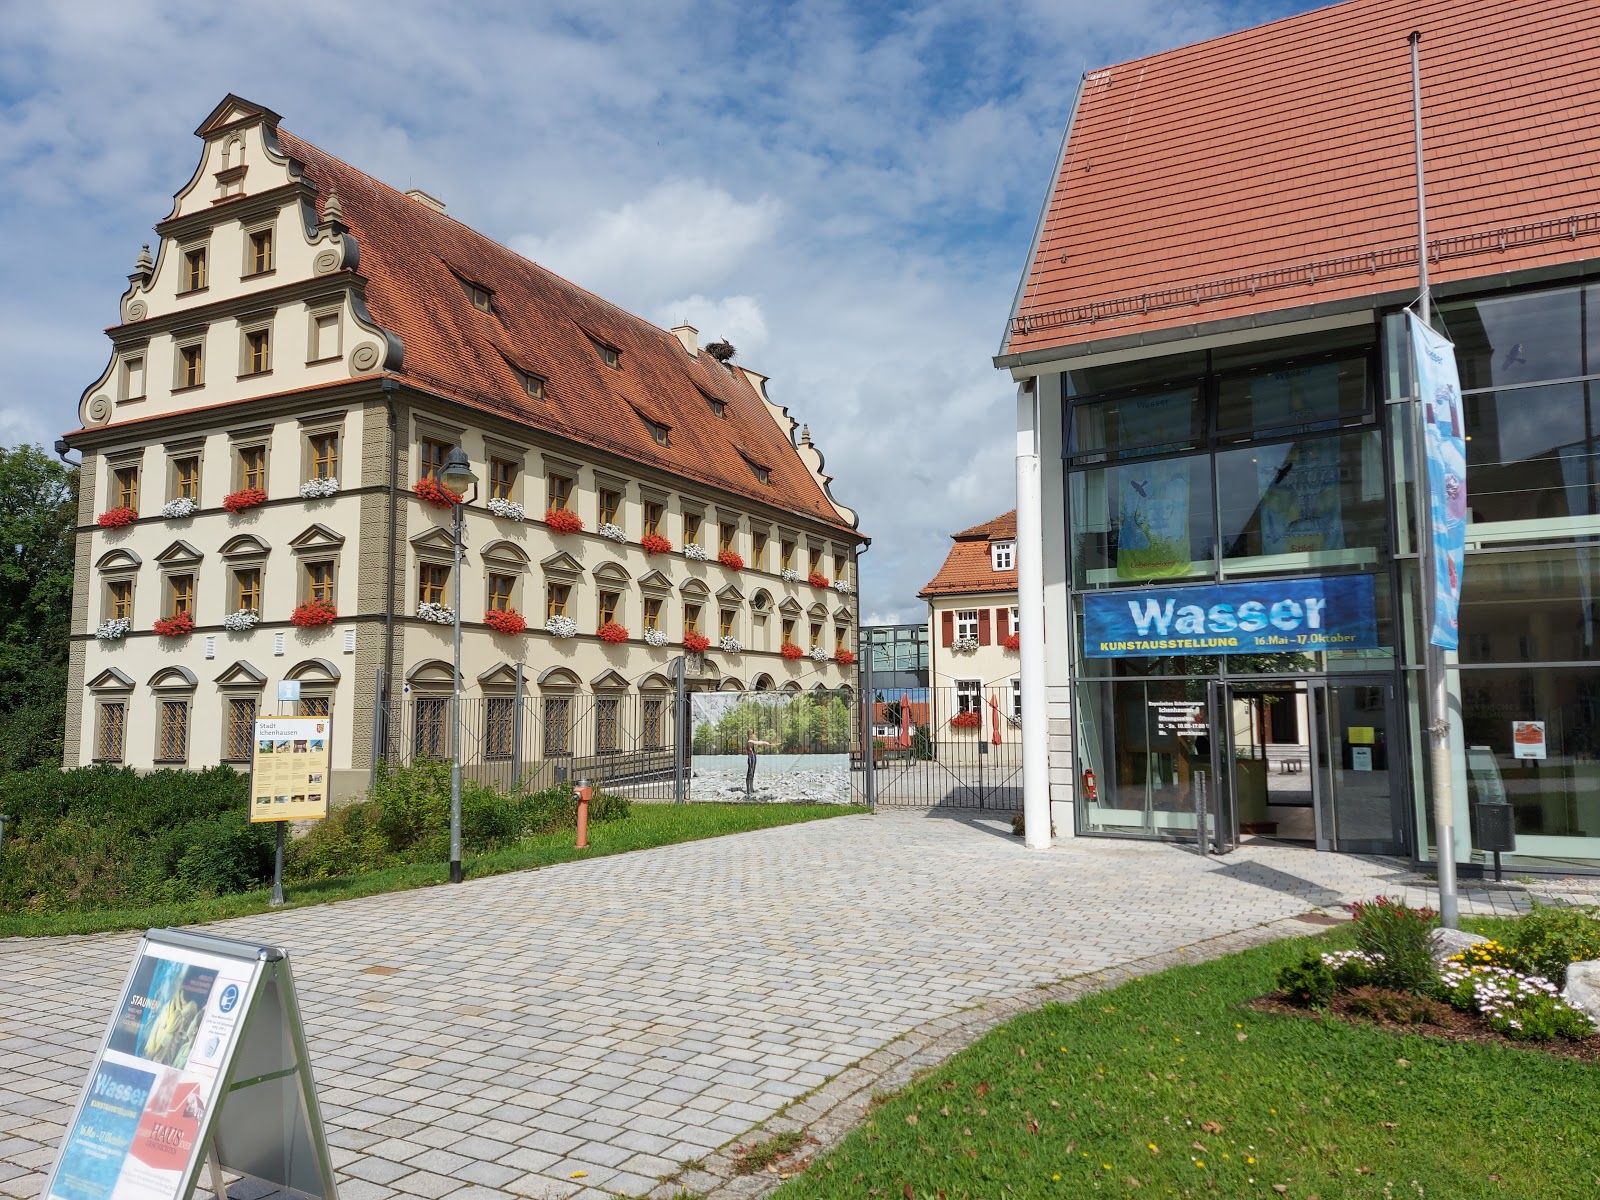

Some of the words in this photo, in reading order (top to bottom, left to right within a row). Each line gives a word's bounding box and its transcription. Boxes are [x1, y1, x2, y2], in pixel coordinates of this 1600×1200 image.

[1127, 597, 1326, 636] Wasser
[1100, 637, 1238, 651] KUNSTAUSSTELLUNG
[94, 1073, 148, 1106] Wasser
